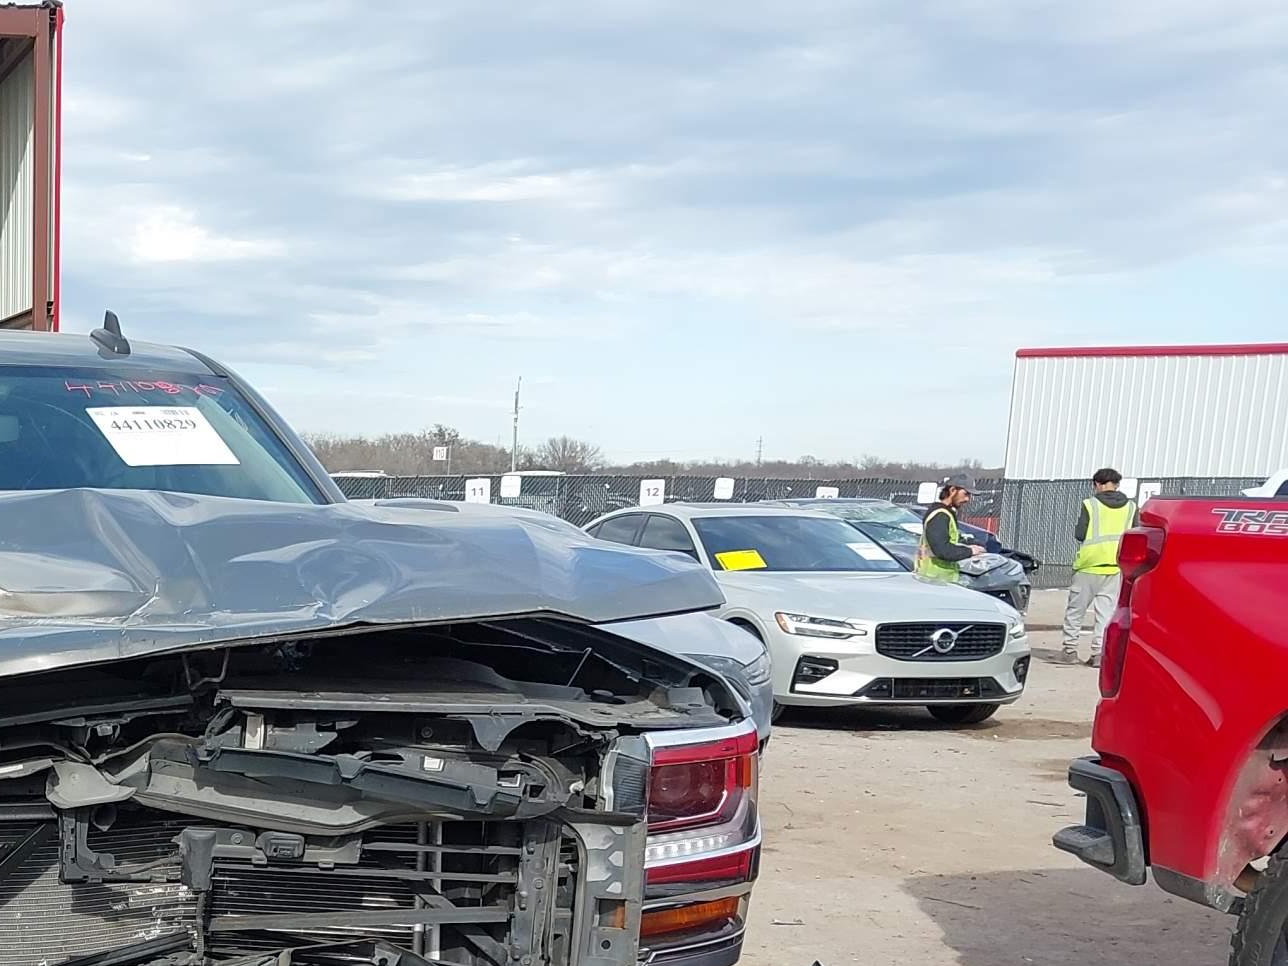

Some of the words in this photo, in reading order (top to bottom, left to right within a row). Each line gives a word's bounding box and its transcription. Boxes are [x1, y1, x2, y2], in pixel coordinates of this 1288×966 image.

[111, 419, 197, 431] 44110829
[471, 487, 484, 497] 11
[646, 487, 660, 497] 12
